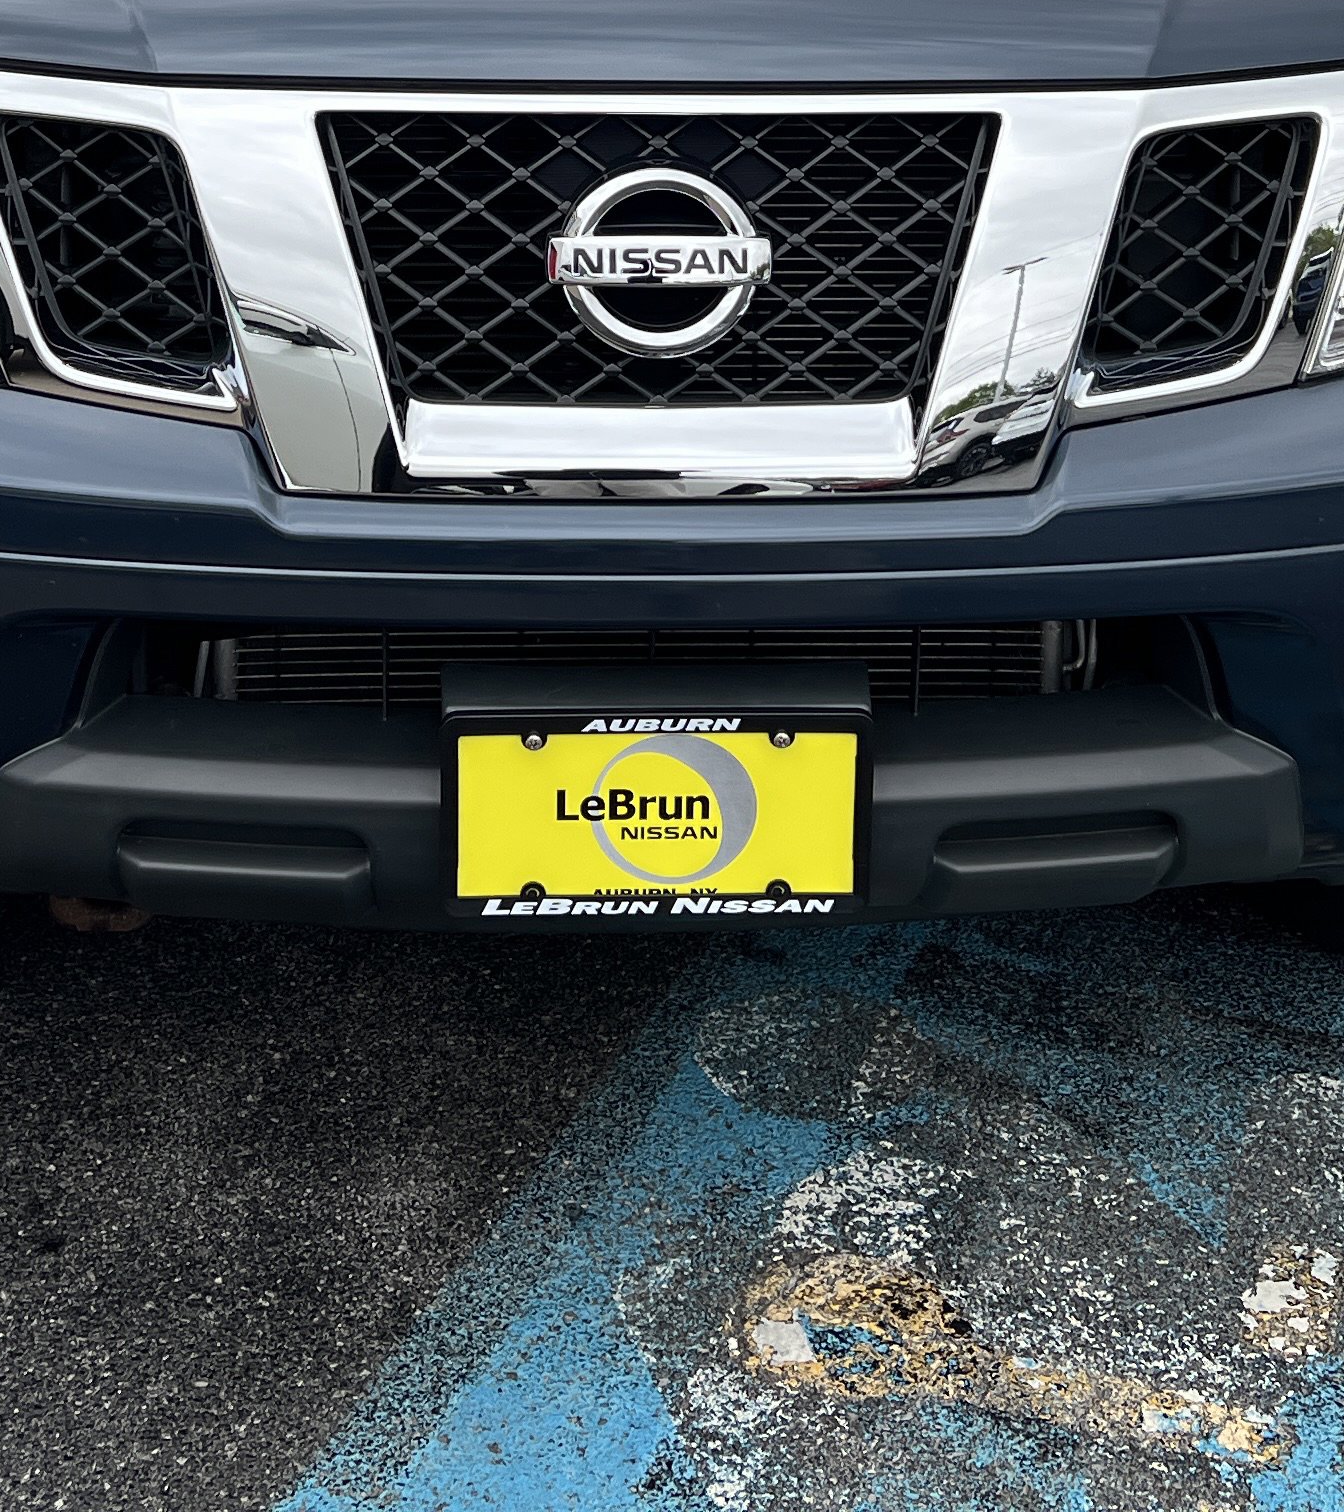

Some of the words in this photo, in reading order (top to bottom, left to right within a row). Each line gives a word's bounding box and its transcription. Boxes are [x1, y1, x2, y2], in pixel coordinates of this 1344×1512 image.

[572, 247, 749, 275] NISSAN
[580, 717, 742, 733] AUBURN
[555, 788, 711, 822] LeBrun
[619, 825, 719, 840] NISSAN
